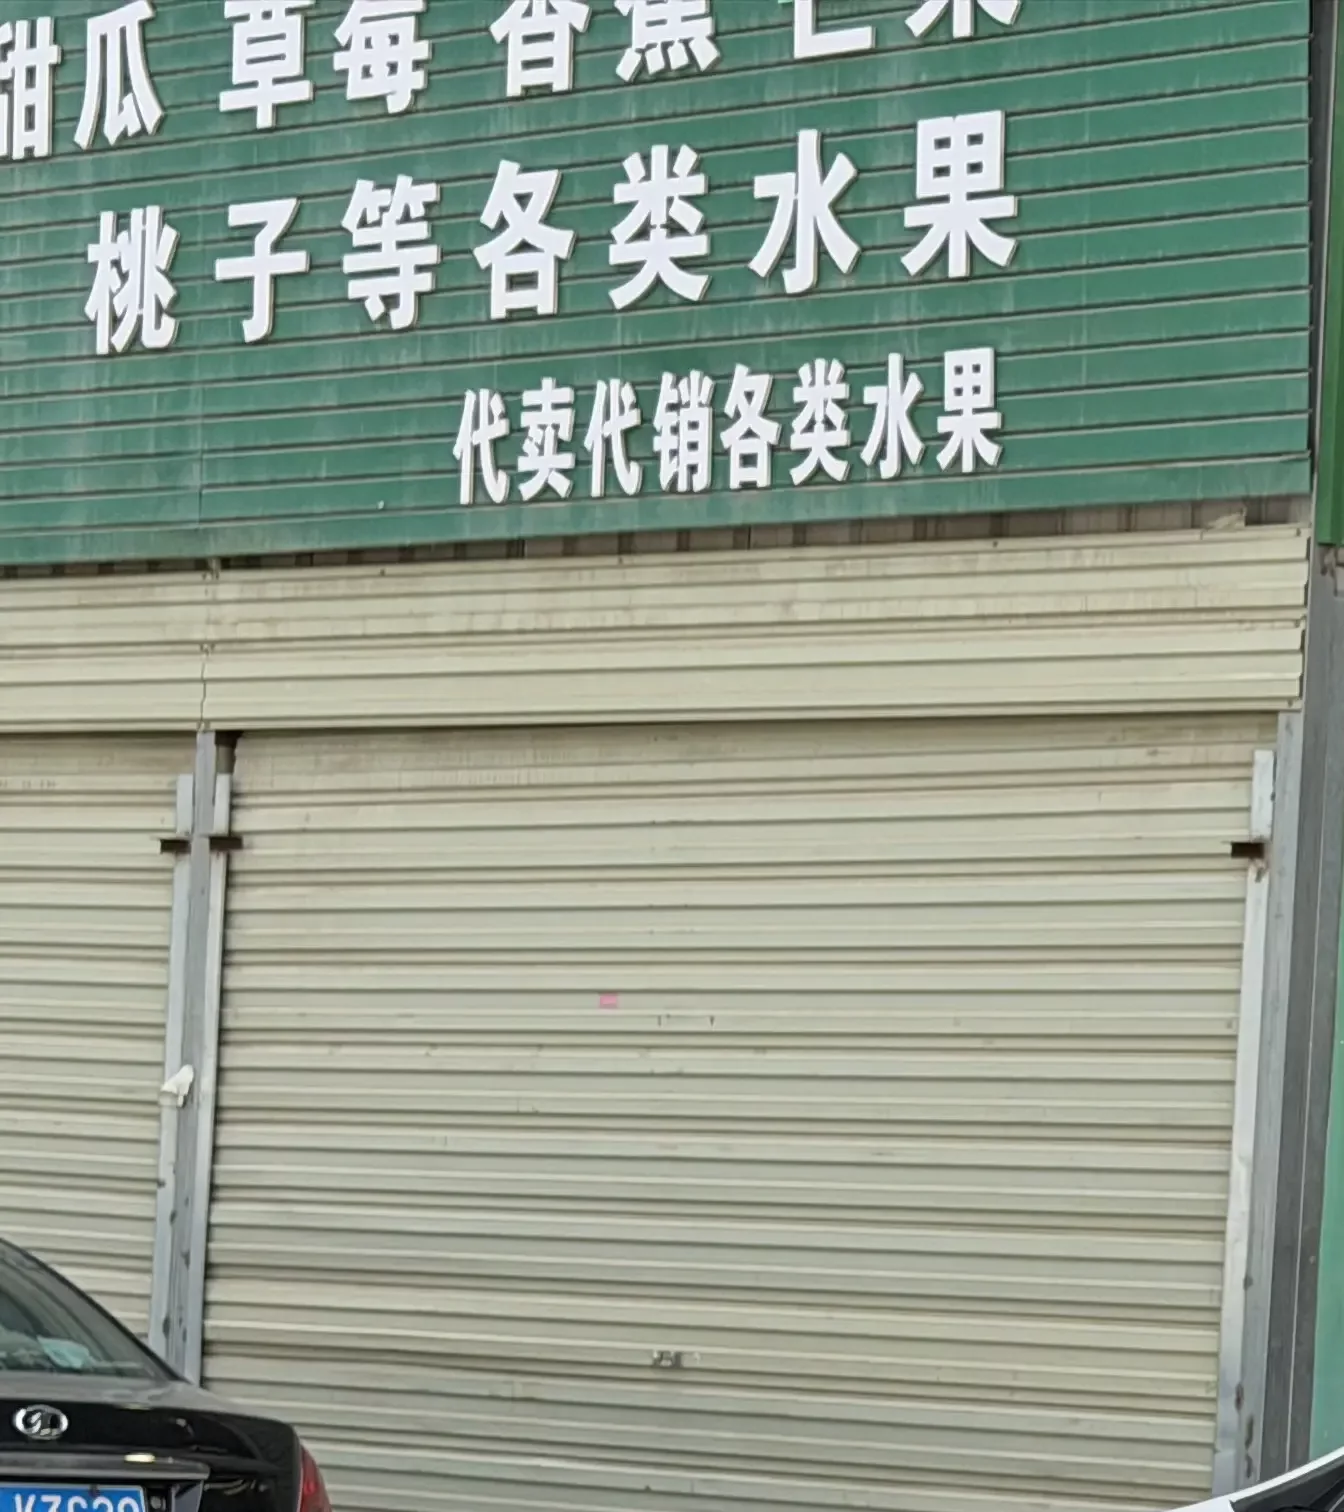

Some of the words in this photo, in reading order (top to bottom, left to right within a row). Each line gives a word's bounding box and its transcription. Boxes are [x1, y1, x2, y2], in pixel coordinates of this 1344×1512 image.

[84, 109, 1018, 355] 桃子等各类水果
[452, 347, 1003, 505] 代卖代销各类水果
